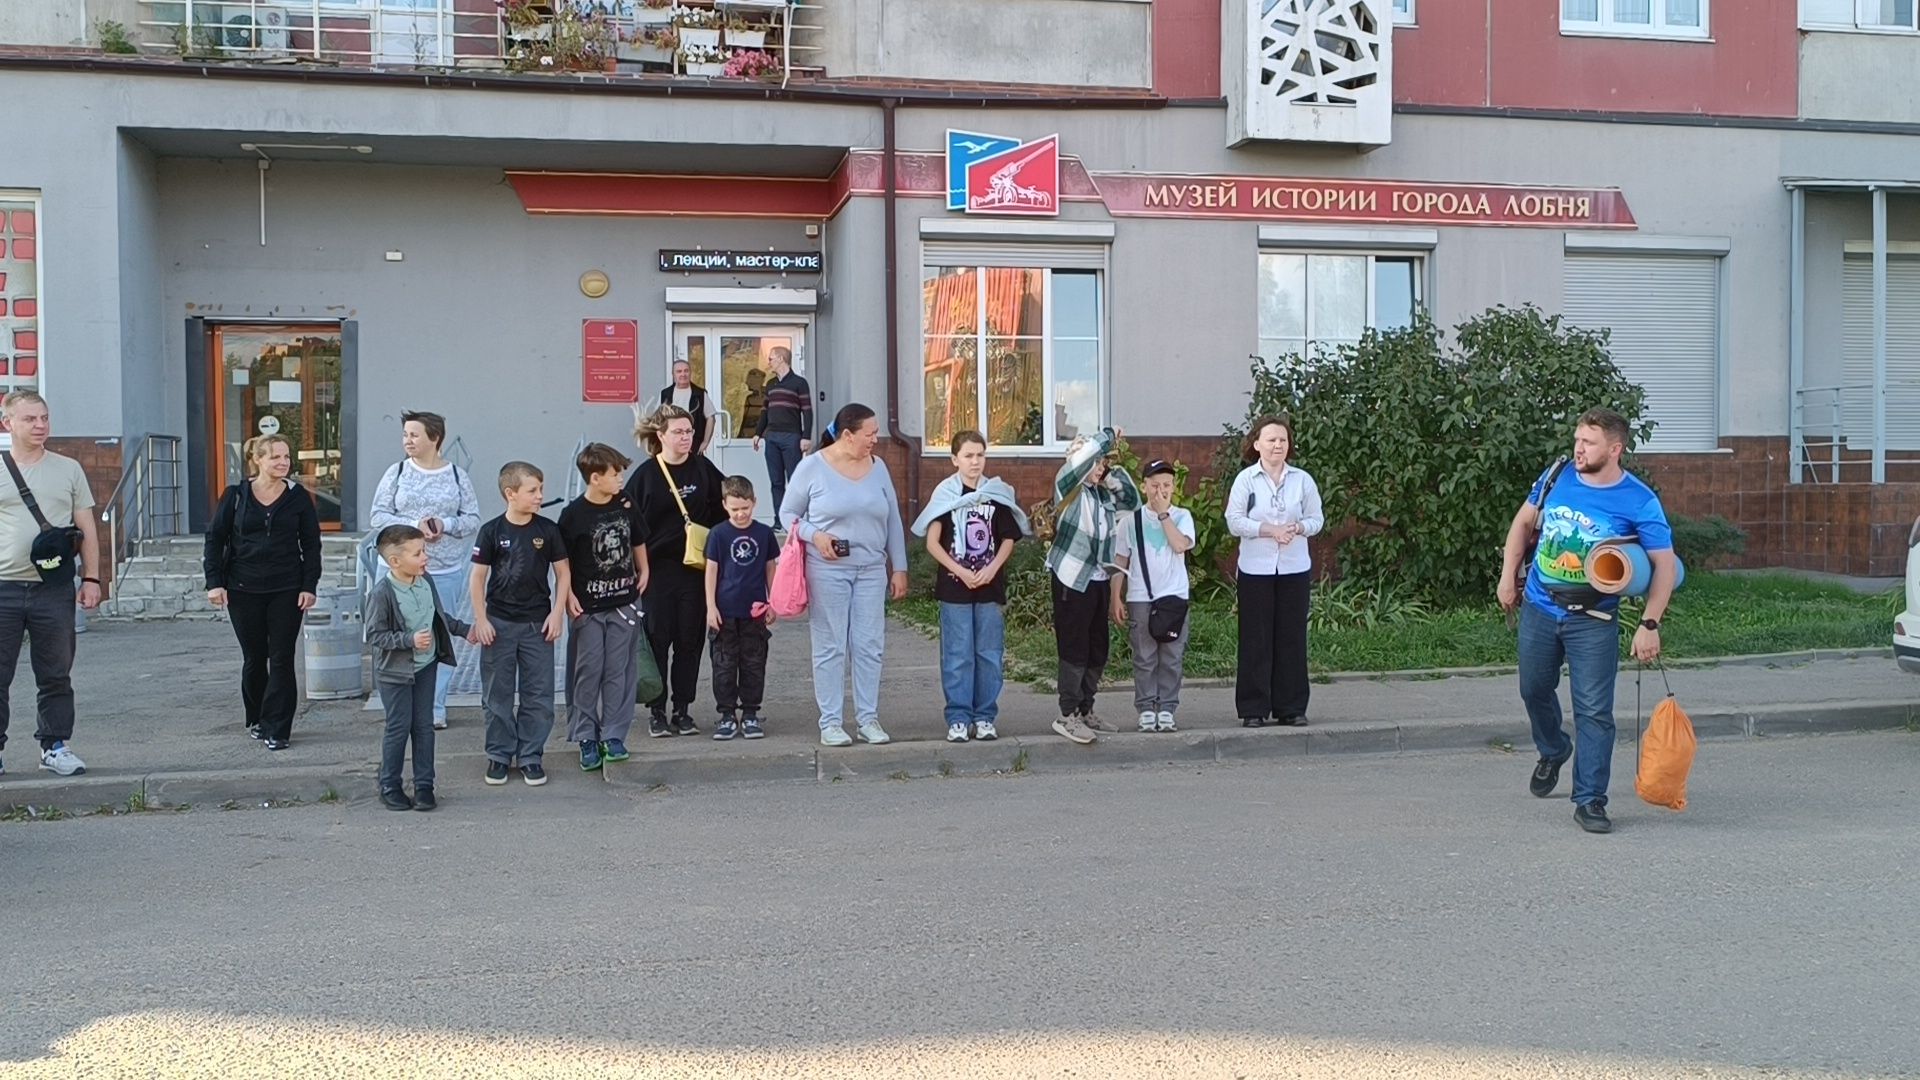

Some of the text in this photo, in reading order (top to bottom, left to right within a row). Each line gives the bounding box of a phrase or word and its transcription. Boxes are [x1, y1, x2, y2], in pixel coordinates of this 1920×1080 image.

[1145, 182, 1590, 217] МУЗЕЙ ИСТОРИИ ГОРОДА ЛОБНЯ
[672, 253, 731, 269] лекции,
